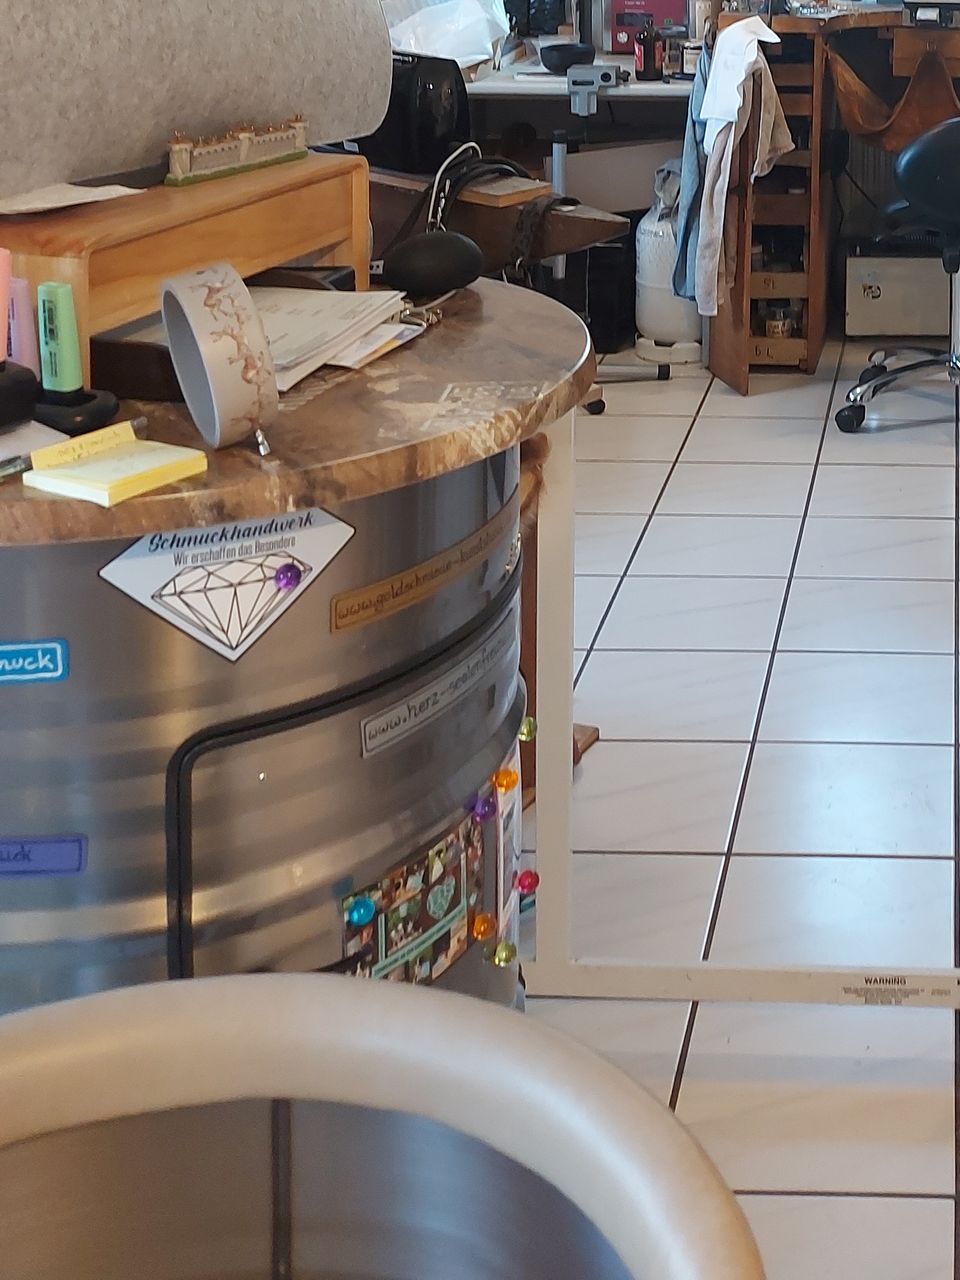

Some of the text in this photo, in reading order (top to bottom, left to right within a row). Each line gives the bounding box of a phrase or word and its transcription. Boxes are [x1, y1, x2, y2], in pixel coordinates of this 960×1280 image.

[148, 511, 314, 553] Schmuckhandwerk
[173, 535, 297, 568] Wir erschaffen das Besondere
[864, 976, 907, 987] WARNING
